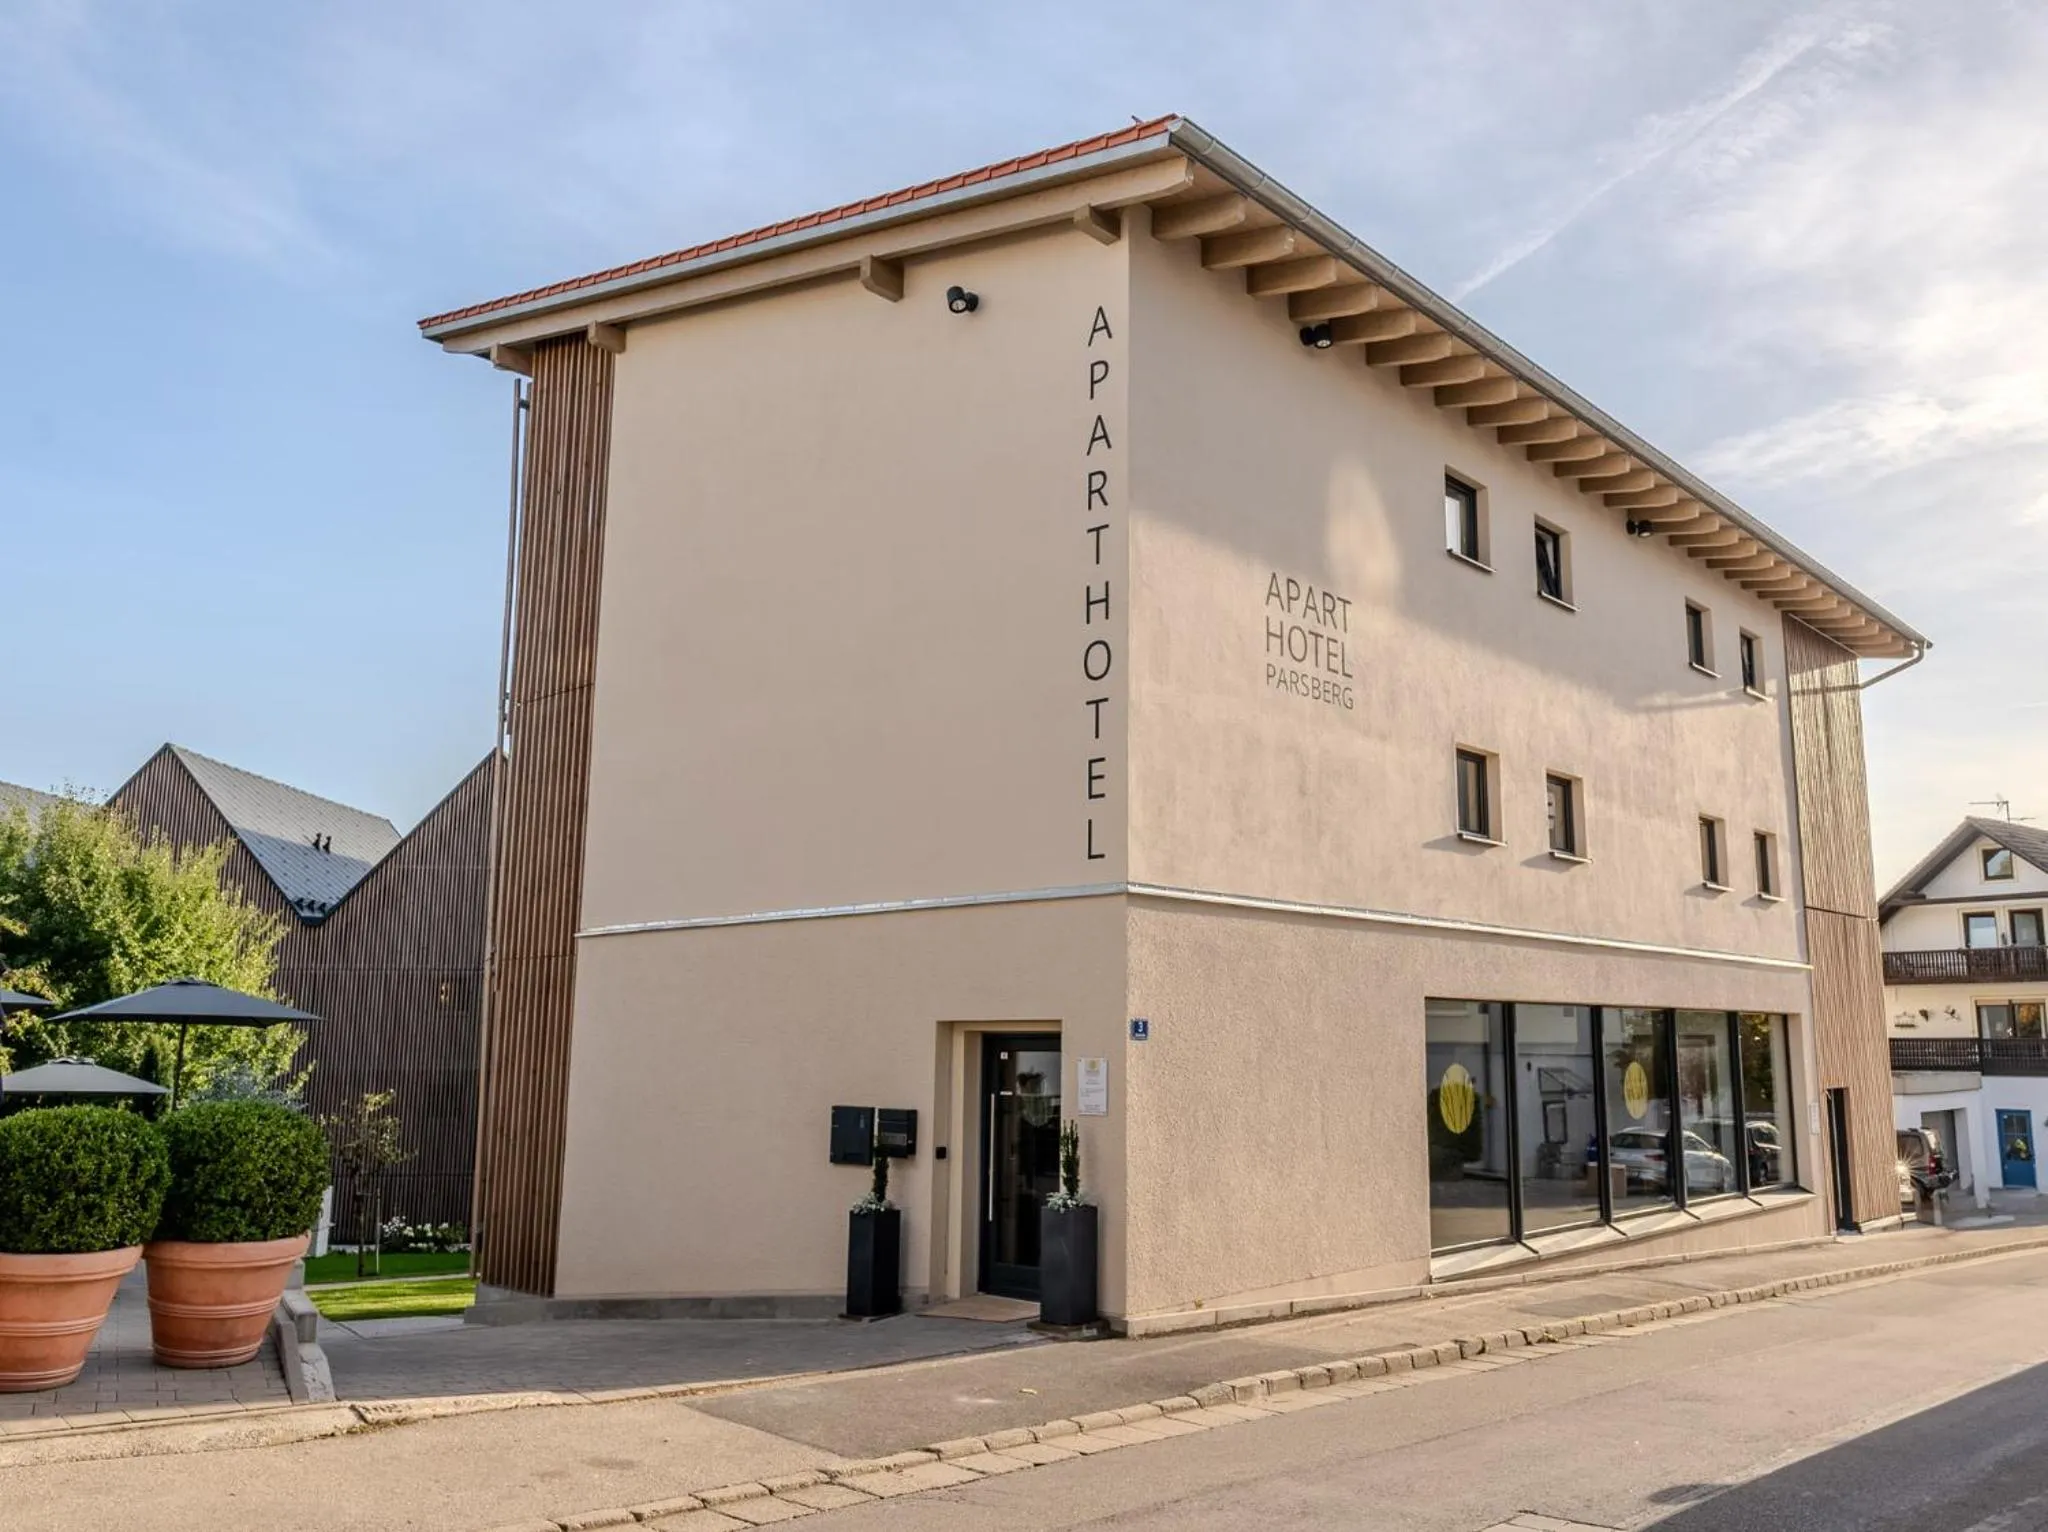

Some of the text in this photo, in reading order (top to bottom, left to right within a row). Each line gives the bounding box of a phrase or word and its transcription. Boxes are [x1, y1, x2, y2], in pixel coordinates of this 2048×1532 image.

[1084, 305, 1113, 860] APARTHOTEL
[1265, 572, 1352, 633] APART
[1266, 615, 1353, 678] HOTEL
[1266, 663, 1354, 710] PARSBERG
